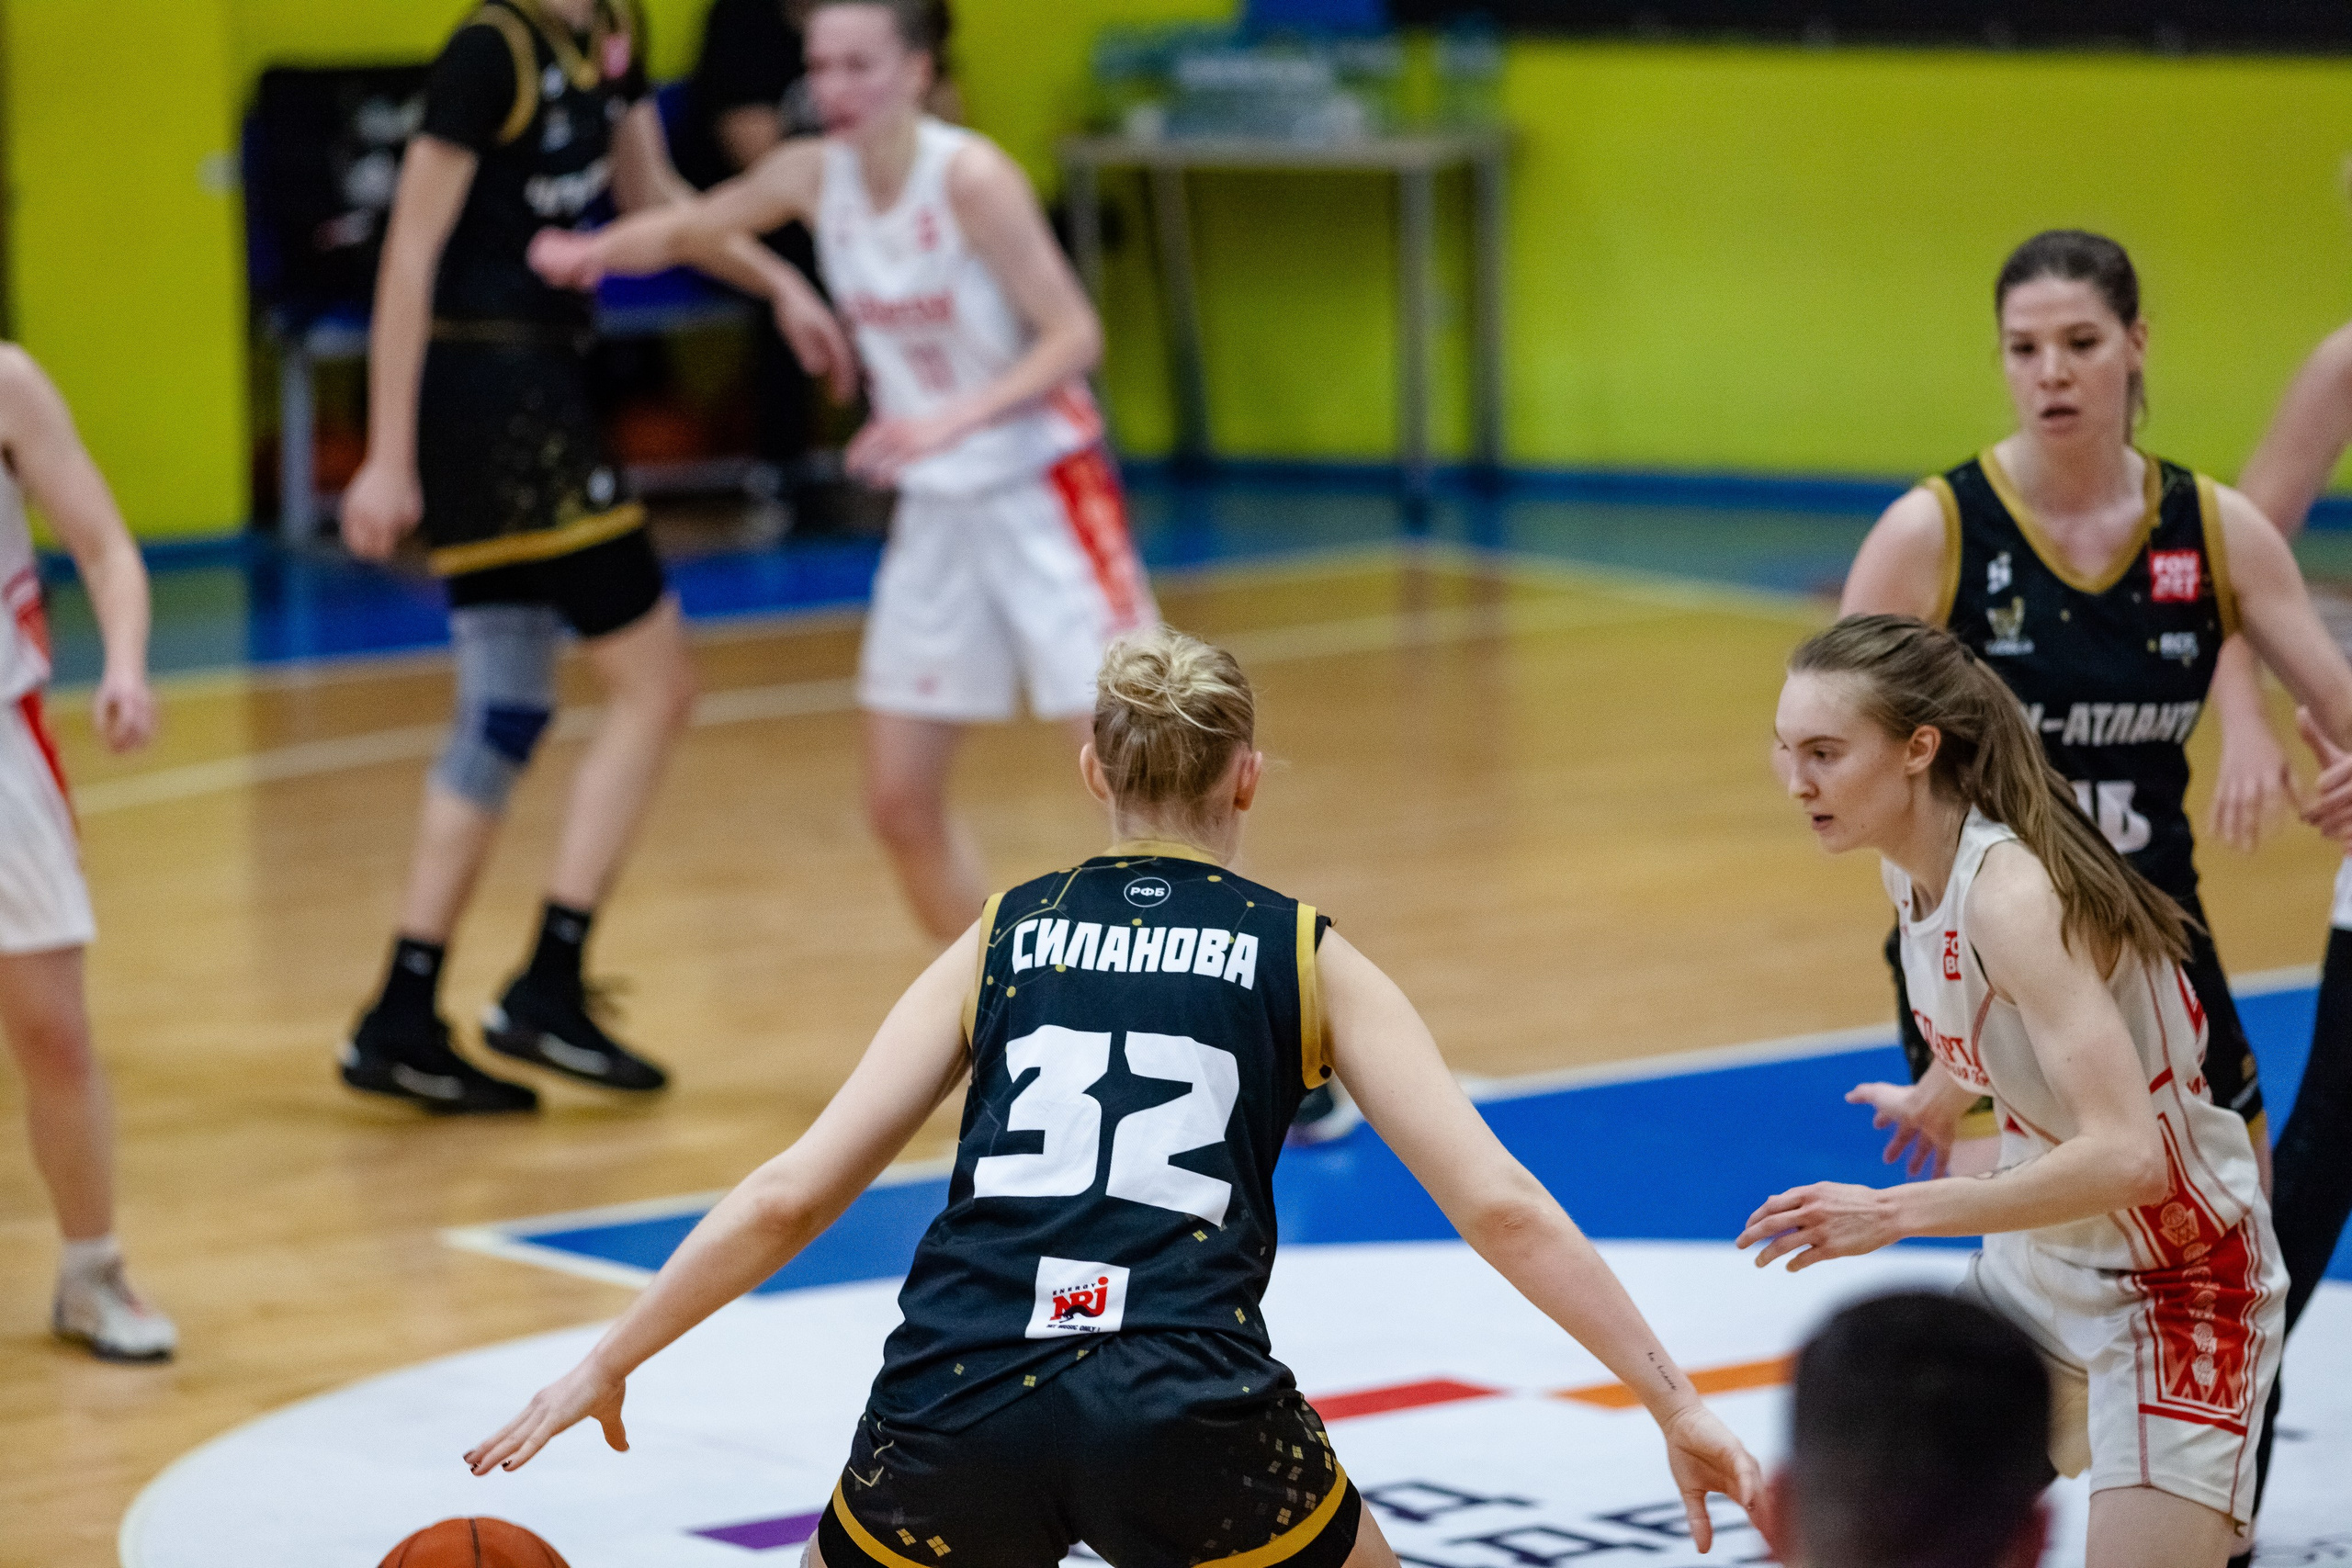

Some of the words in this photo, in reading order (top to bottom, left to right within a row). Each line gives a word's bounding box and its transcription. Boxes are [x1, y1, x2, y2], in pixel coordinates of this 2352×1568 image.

[1130, 885, 1166, 898] РФБ
[1012, 918, 1259, 990] СИЛАНОВА
[973, 1023, 1239, 1227] 32
[1049, 1276, 1109, 1321] NRJ
[1053, 1282, 1097, 1296] ENERGY
